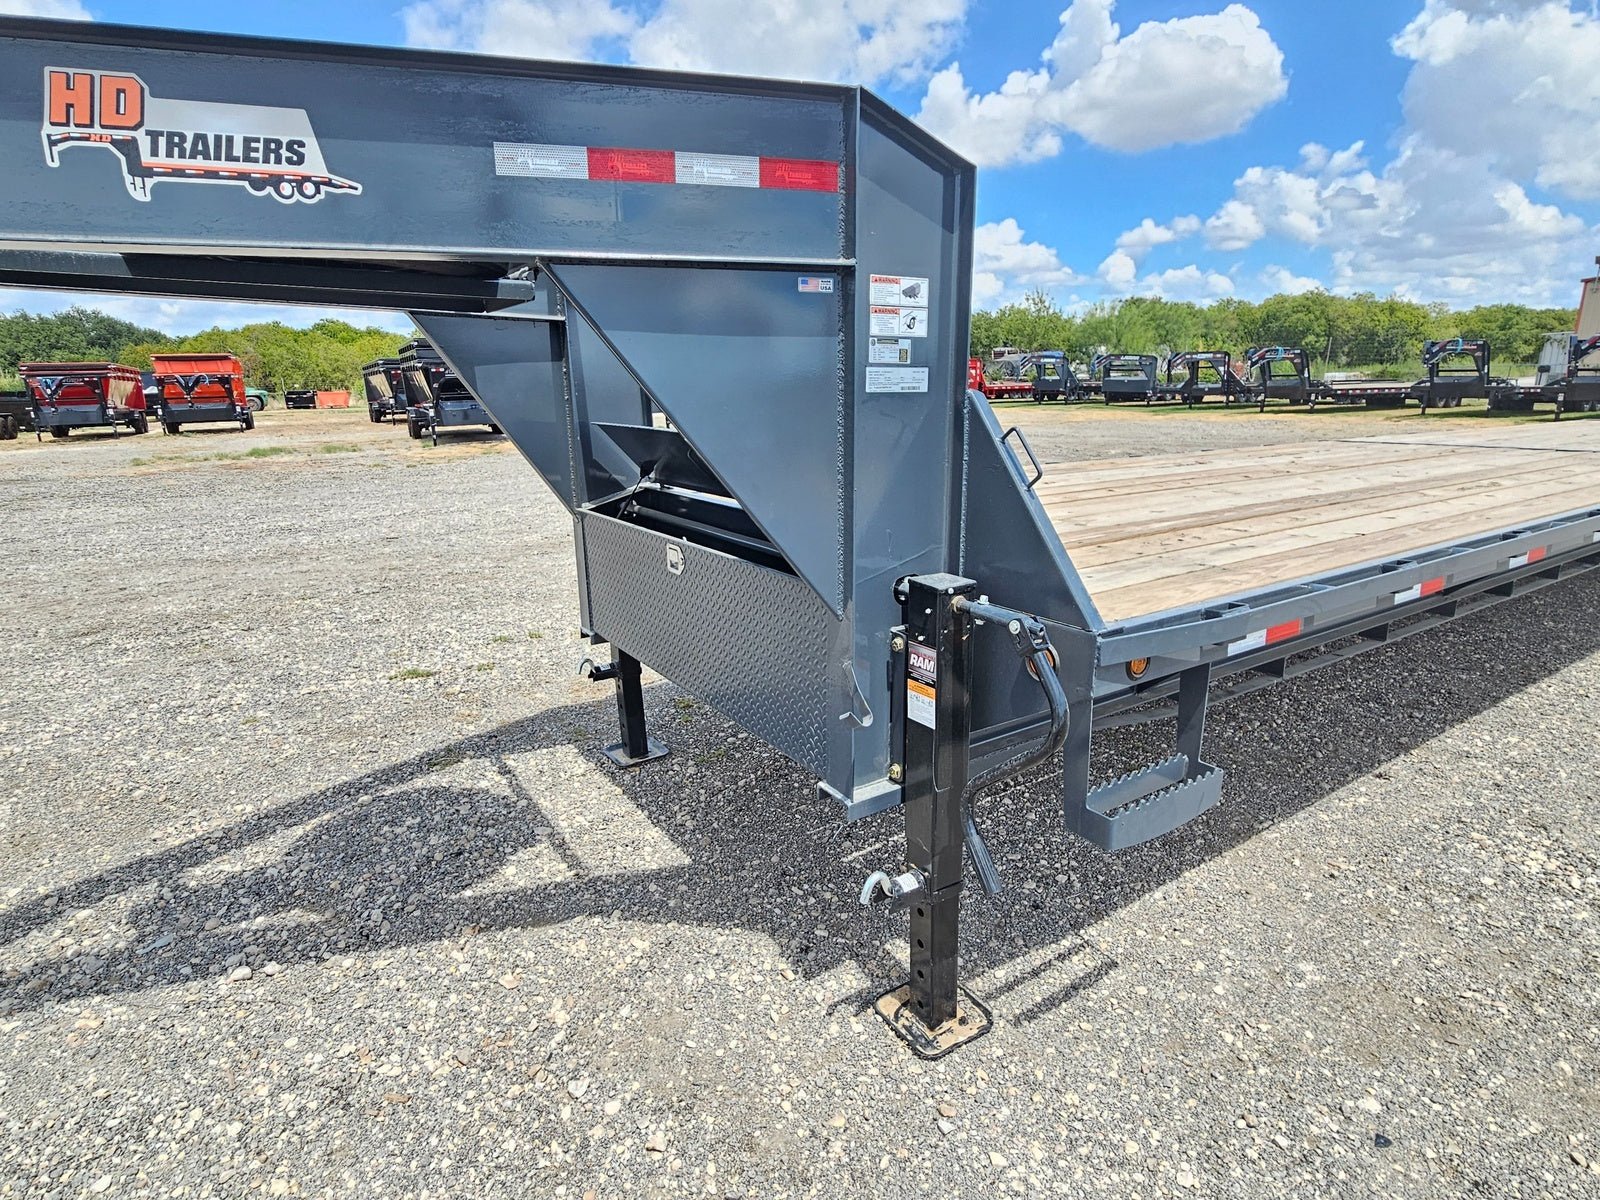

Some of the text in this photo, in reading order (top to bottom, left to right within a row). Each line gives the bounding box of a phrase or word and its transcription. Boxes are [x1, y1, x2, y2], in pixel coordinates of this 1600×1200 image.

[48, 70, 144, 131] HD
[90, 134, 112, 143] HD
[145, 129, 306, 167] TRAILERS
[909, 653, 935, 673] RAM
